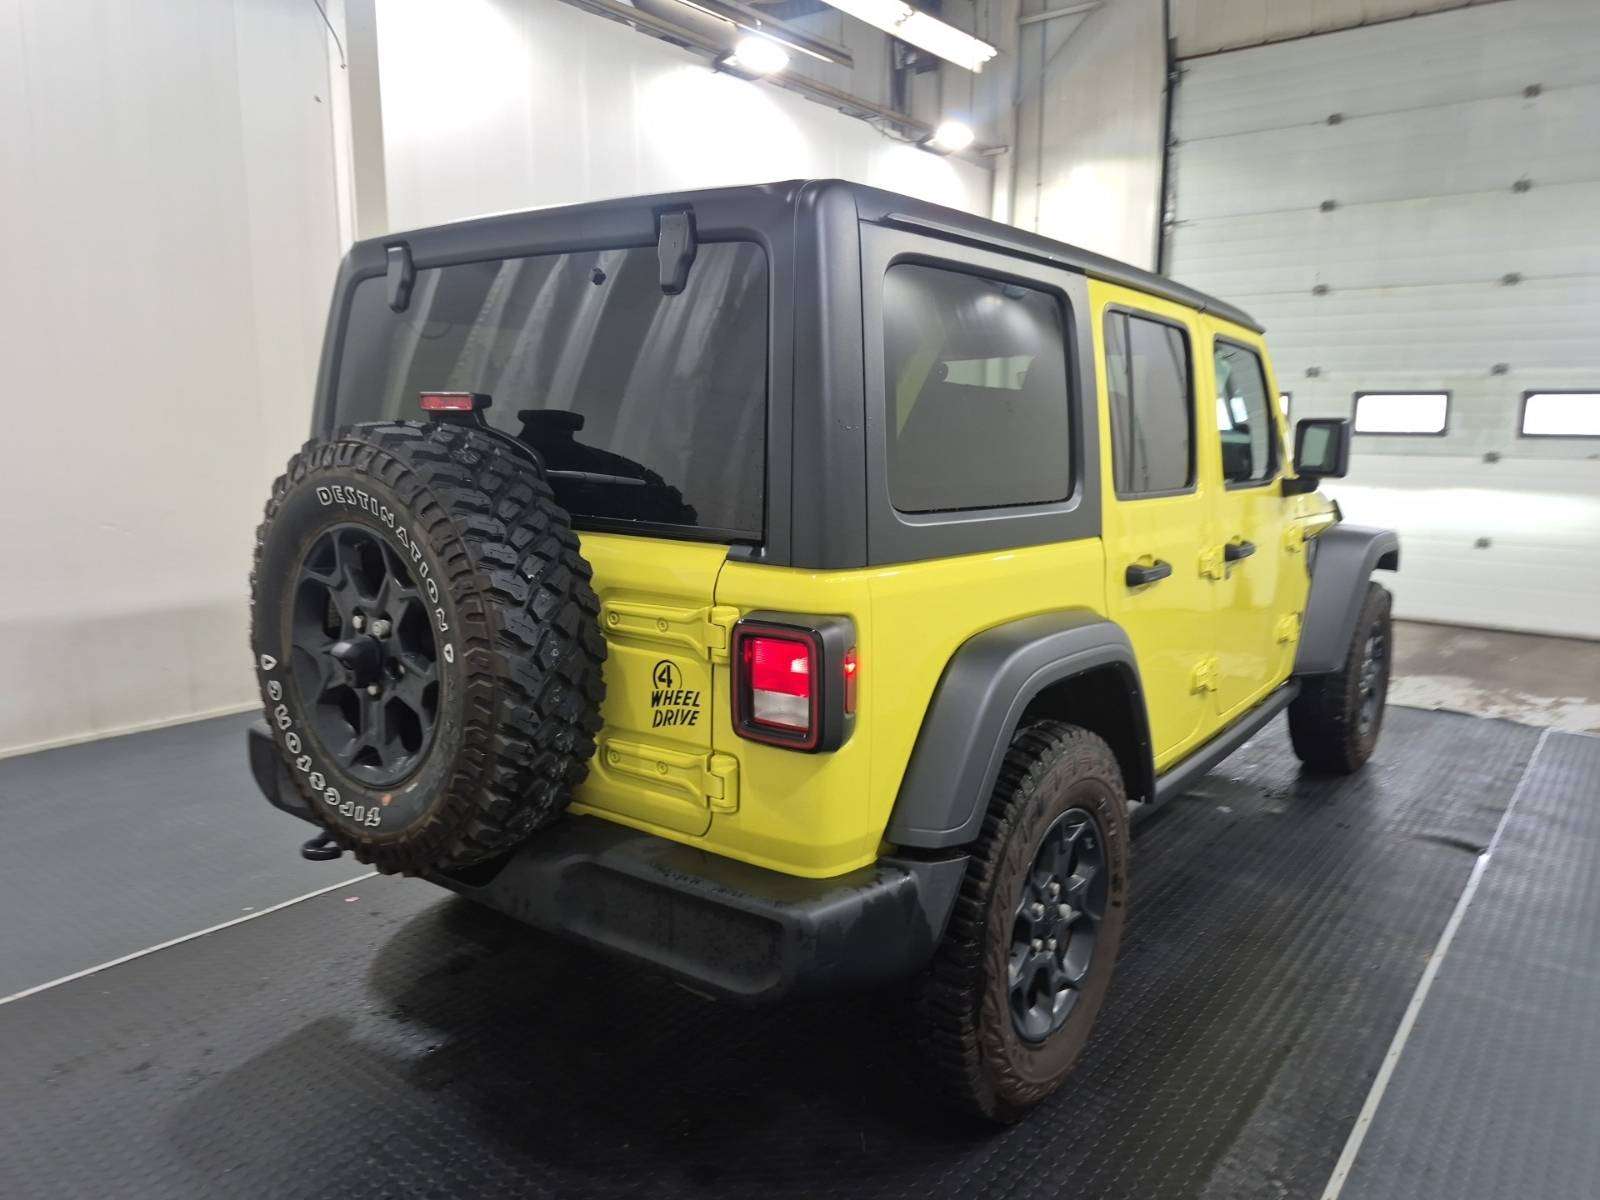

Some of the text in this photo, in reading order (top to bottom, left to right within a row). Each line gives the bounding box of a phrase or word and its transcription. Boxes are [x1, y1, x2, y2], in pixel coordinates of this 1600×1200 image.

[316, 486, 449, 632] DESTINATION
[657, 664, 673, 689] 4
[651, 690, 700, 708] WHEEL
[652, 709, 700, 728] DRIVE
